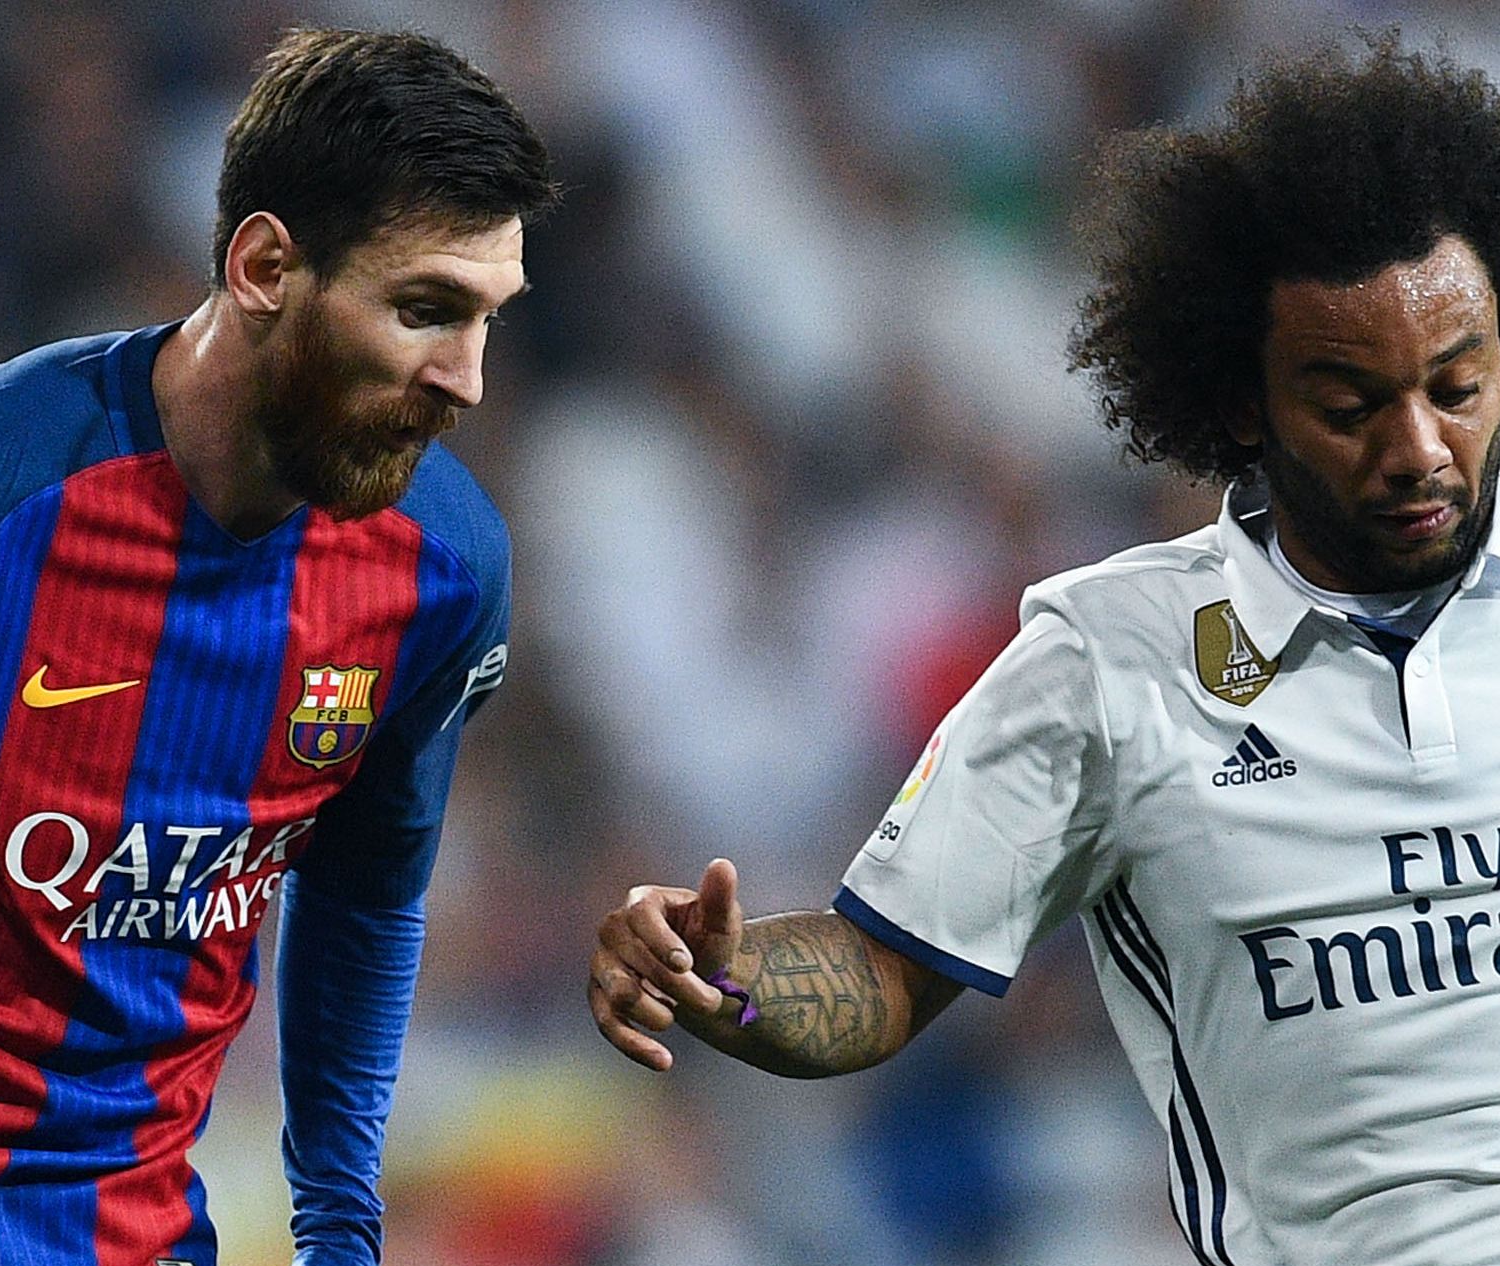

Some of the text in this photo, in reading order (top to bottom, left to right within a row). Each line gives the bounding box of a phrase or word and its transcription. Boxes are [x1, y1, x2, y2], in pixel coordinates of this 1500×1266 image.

[1222, 662, 1261, 683] FIFA
[316, 709, 349, 722] FCB
[1212, 759, 1297, 788] adidas
[4, 811, 317, 912] QATAR
